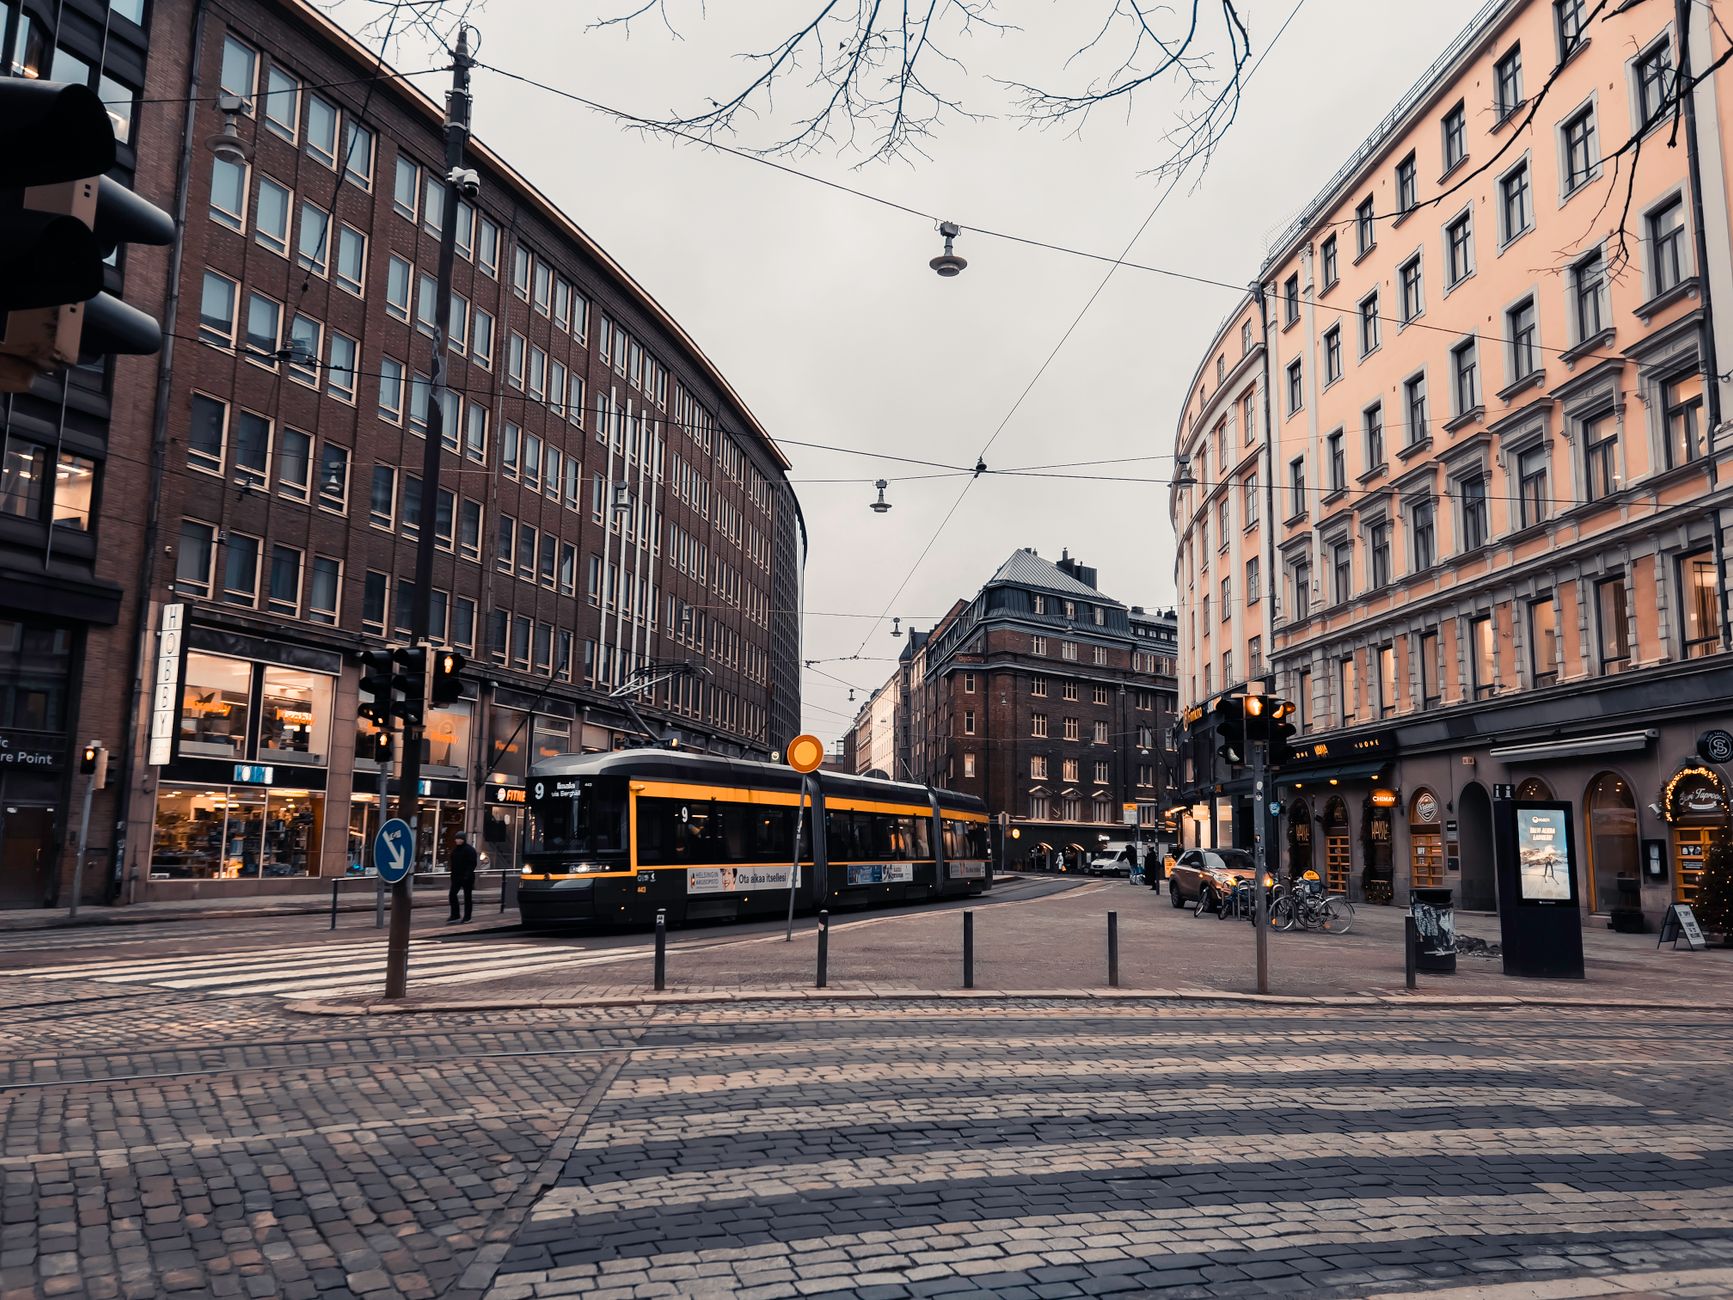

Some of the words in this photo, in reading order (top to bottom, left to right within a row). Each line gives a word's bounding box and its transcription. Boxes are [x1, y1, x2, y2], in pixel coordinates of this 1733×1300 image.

[160, 606, 178, 736] HOBBY
[17, 751, 53, 765] Point
[534, 782, 545, 800] 9
[1372, 795, 1396, 803] CHIMAY
[681, 806, 688, 823] 9
[738, 873, 750, 884] Ota
[750, 873, 766, 884] aikaa
[766, 872, 787, 883] itsellesi
